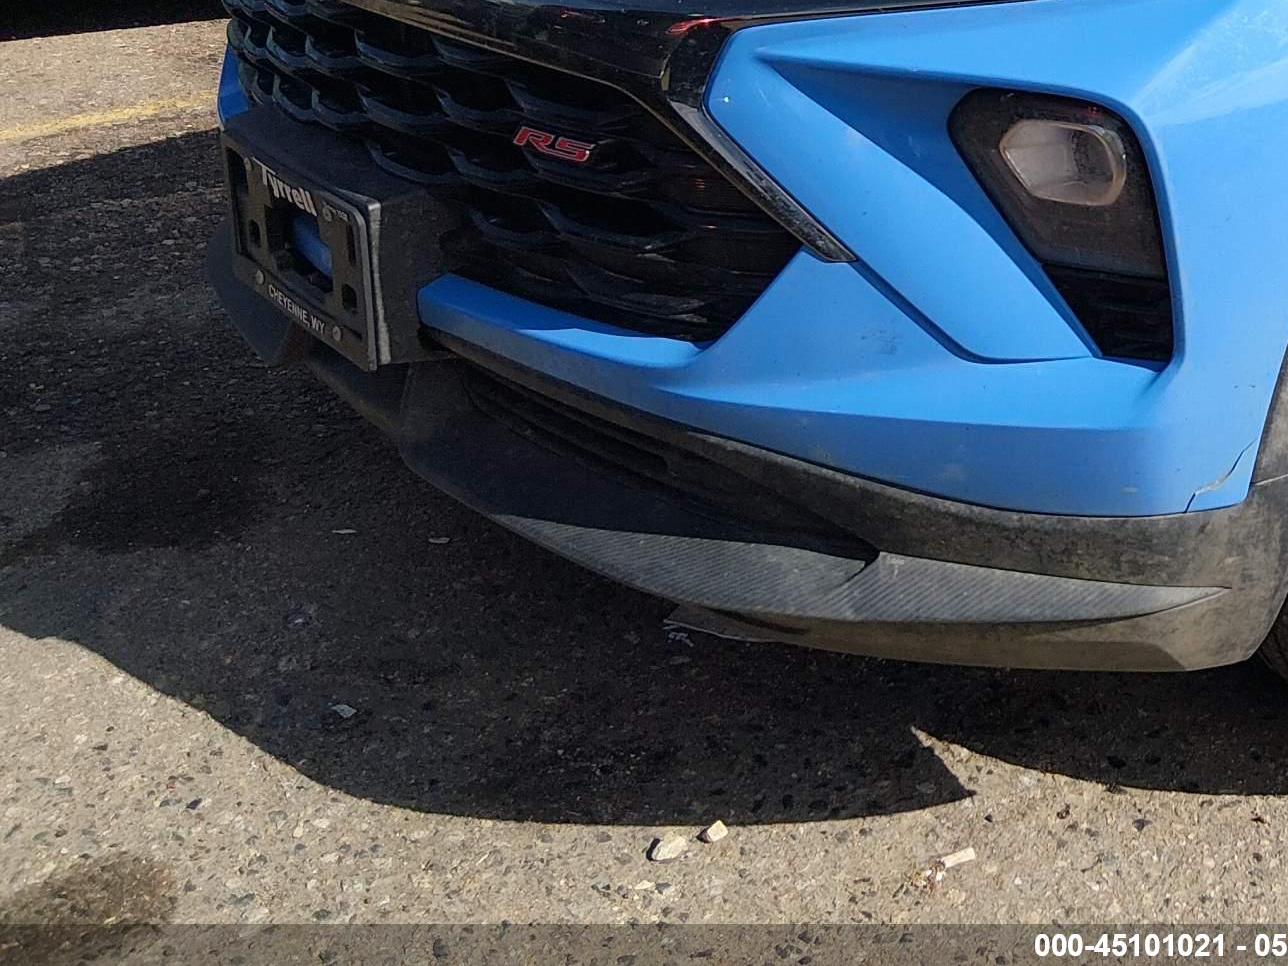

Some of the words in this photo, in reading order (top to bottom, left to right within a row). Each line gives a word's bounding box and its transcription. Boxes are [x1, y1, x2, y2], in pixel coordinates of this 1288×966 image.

[512, 125, 597, 162] RS
[252, 156, 318, 216] Tyrrell
[310, 315, 326, 334] WY
